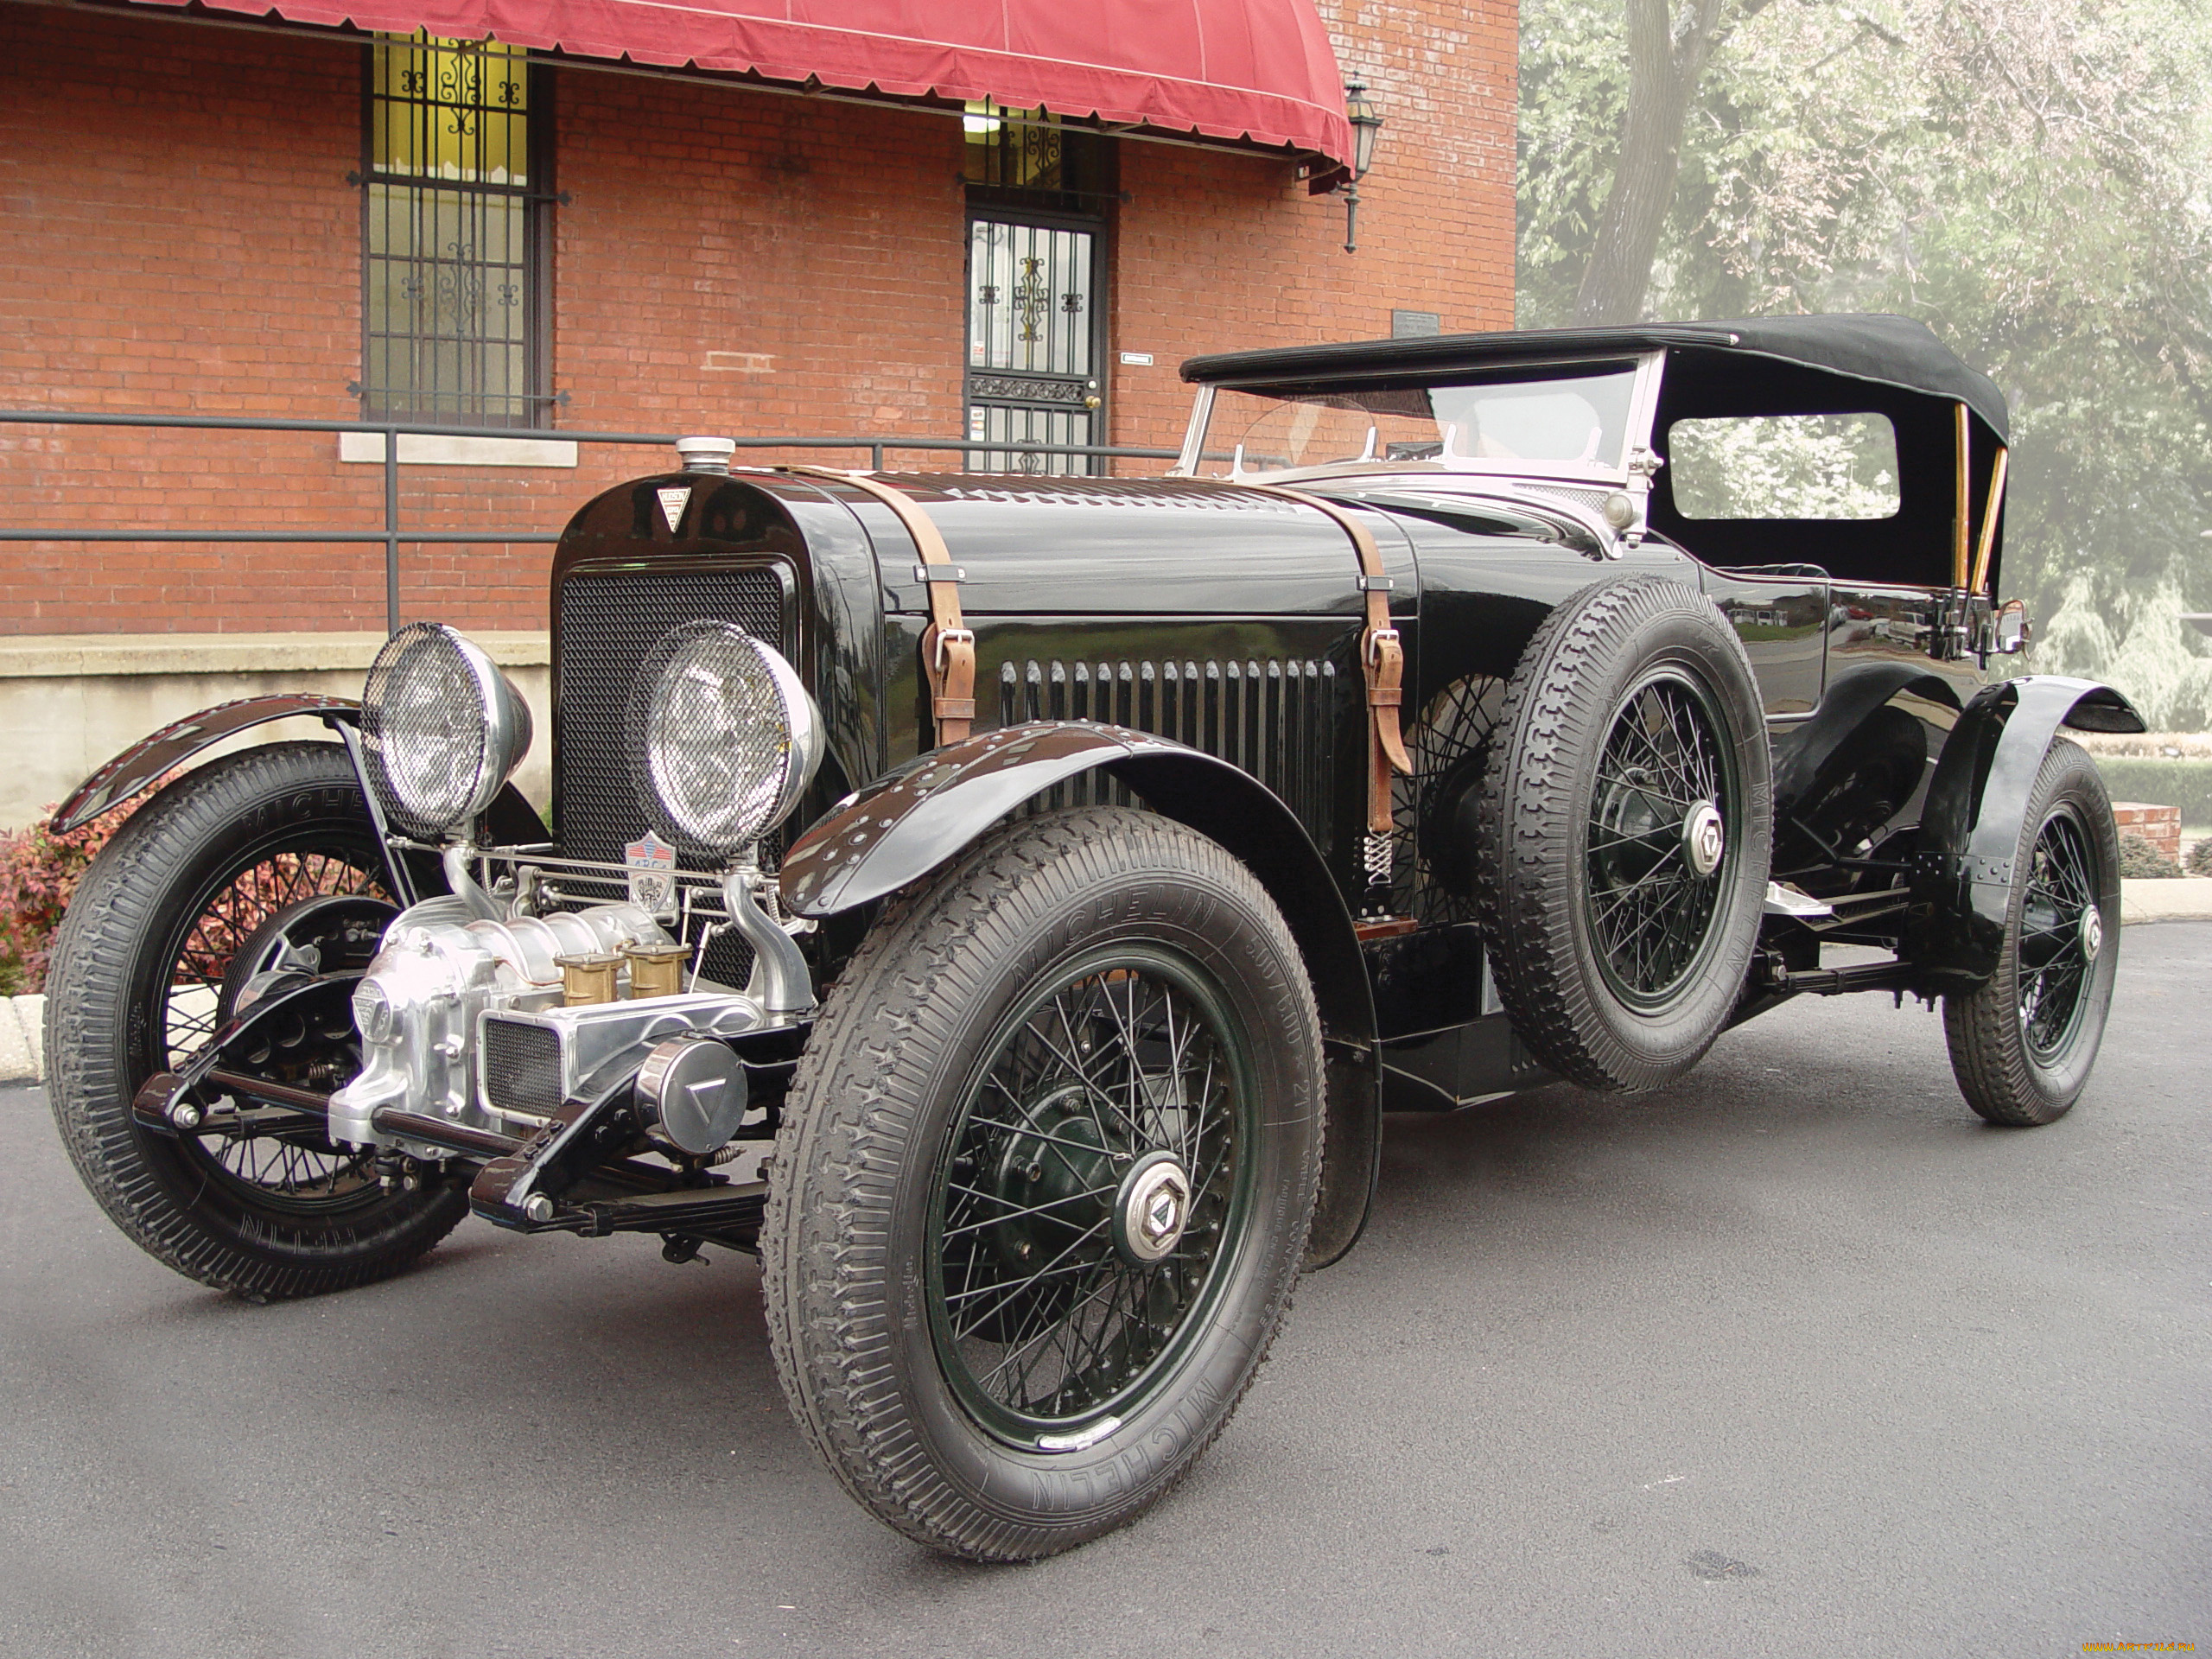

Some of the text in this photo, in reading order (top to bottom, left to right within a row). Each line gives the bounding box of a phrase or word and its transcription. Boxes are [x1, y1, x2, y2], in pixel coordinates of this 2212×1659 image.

[1010, 884, 1218, 995] MICHELIN
[1726, 780, 1769, 976] MICHELIN
[1032, 1376, 1223, 1510] MICHELIN
